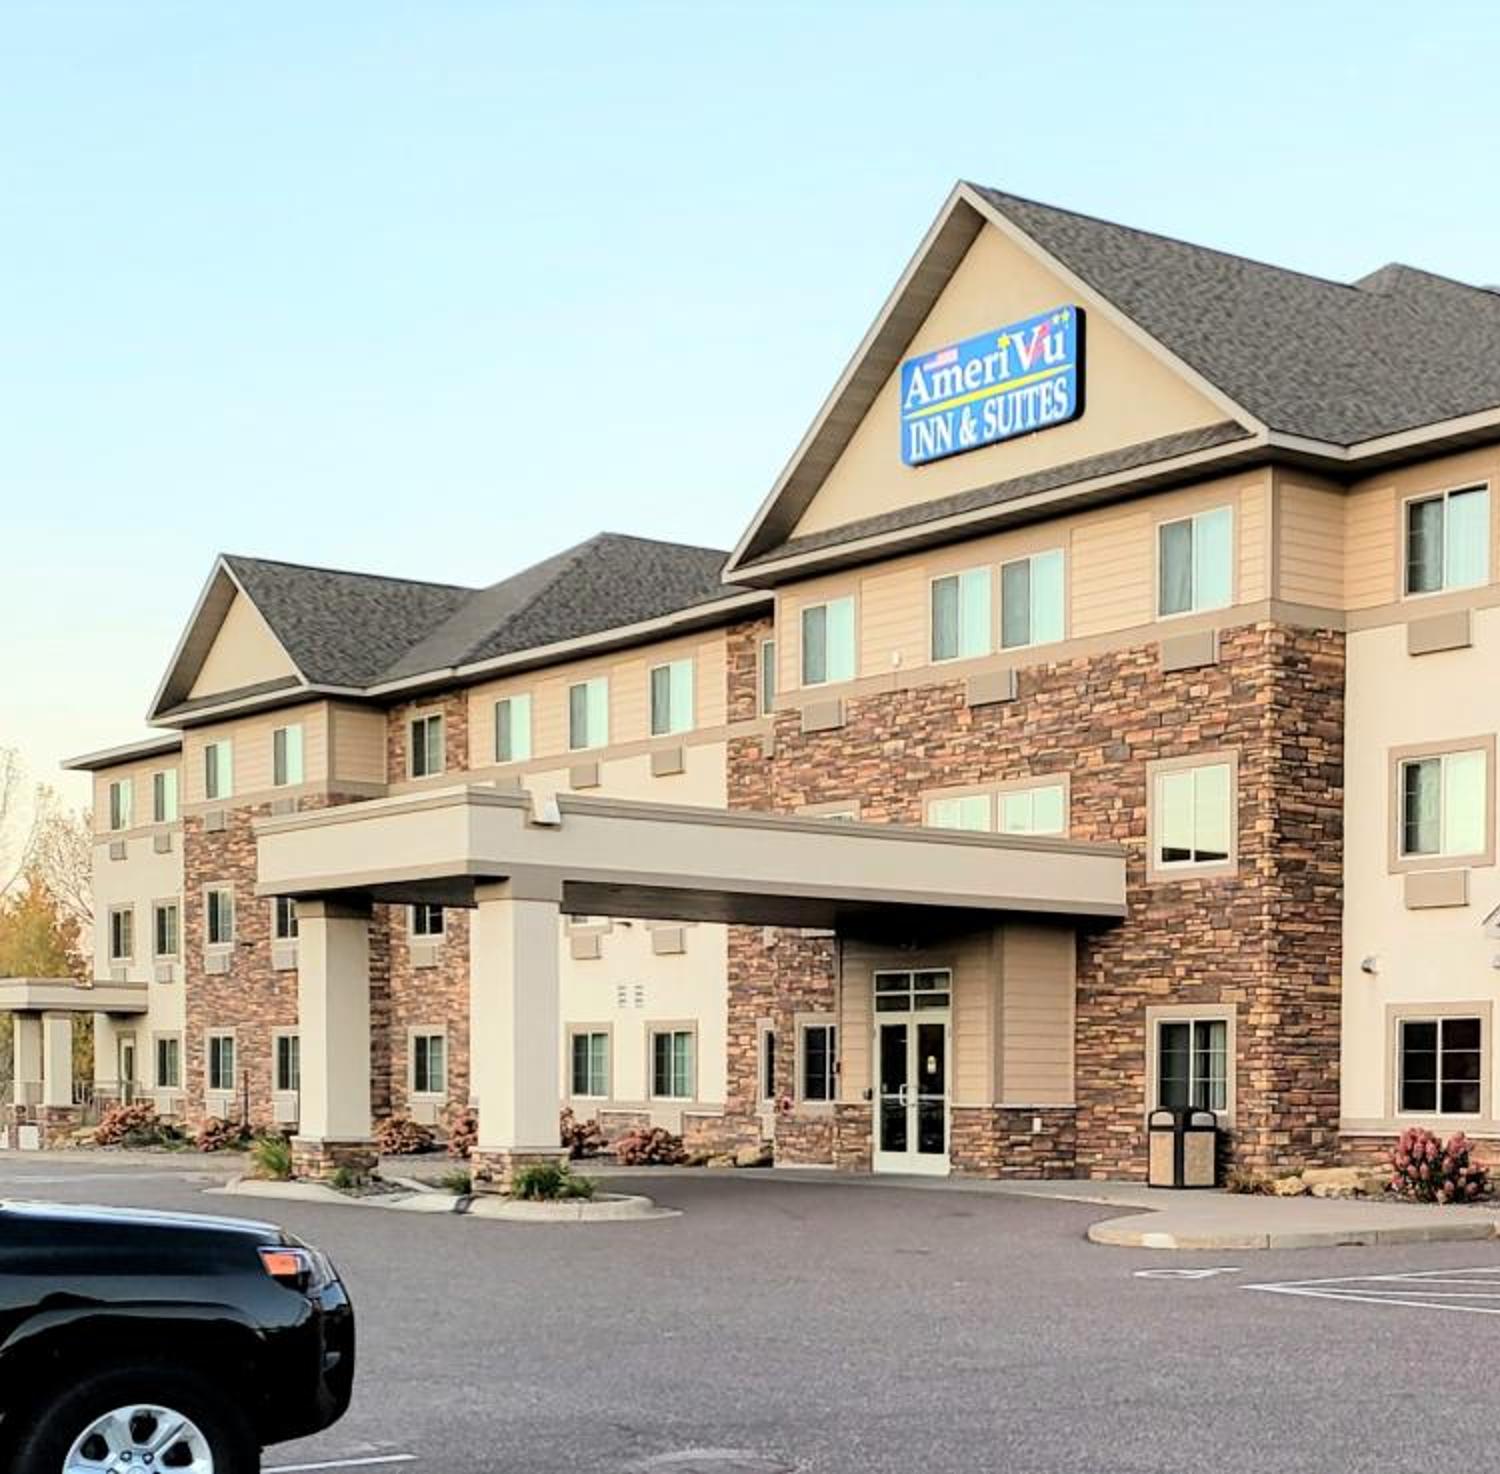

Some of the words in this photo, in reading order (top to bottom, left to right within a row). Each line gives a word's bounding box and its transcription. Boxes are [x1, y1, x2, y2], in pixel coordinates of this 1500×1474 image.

[904, 322, 1068, 409] AmeriVu
[909, 412, 954, 461] INN
[959, 406, 979, 446] &
[983, 376, 1068, 439] SUITES
